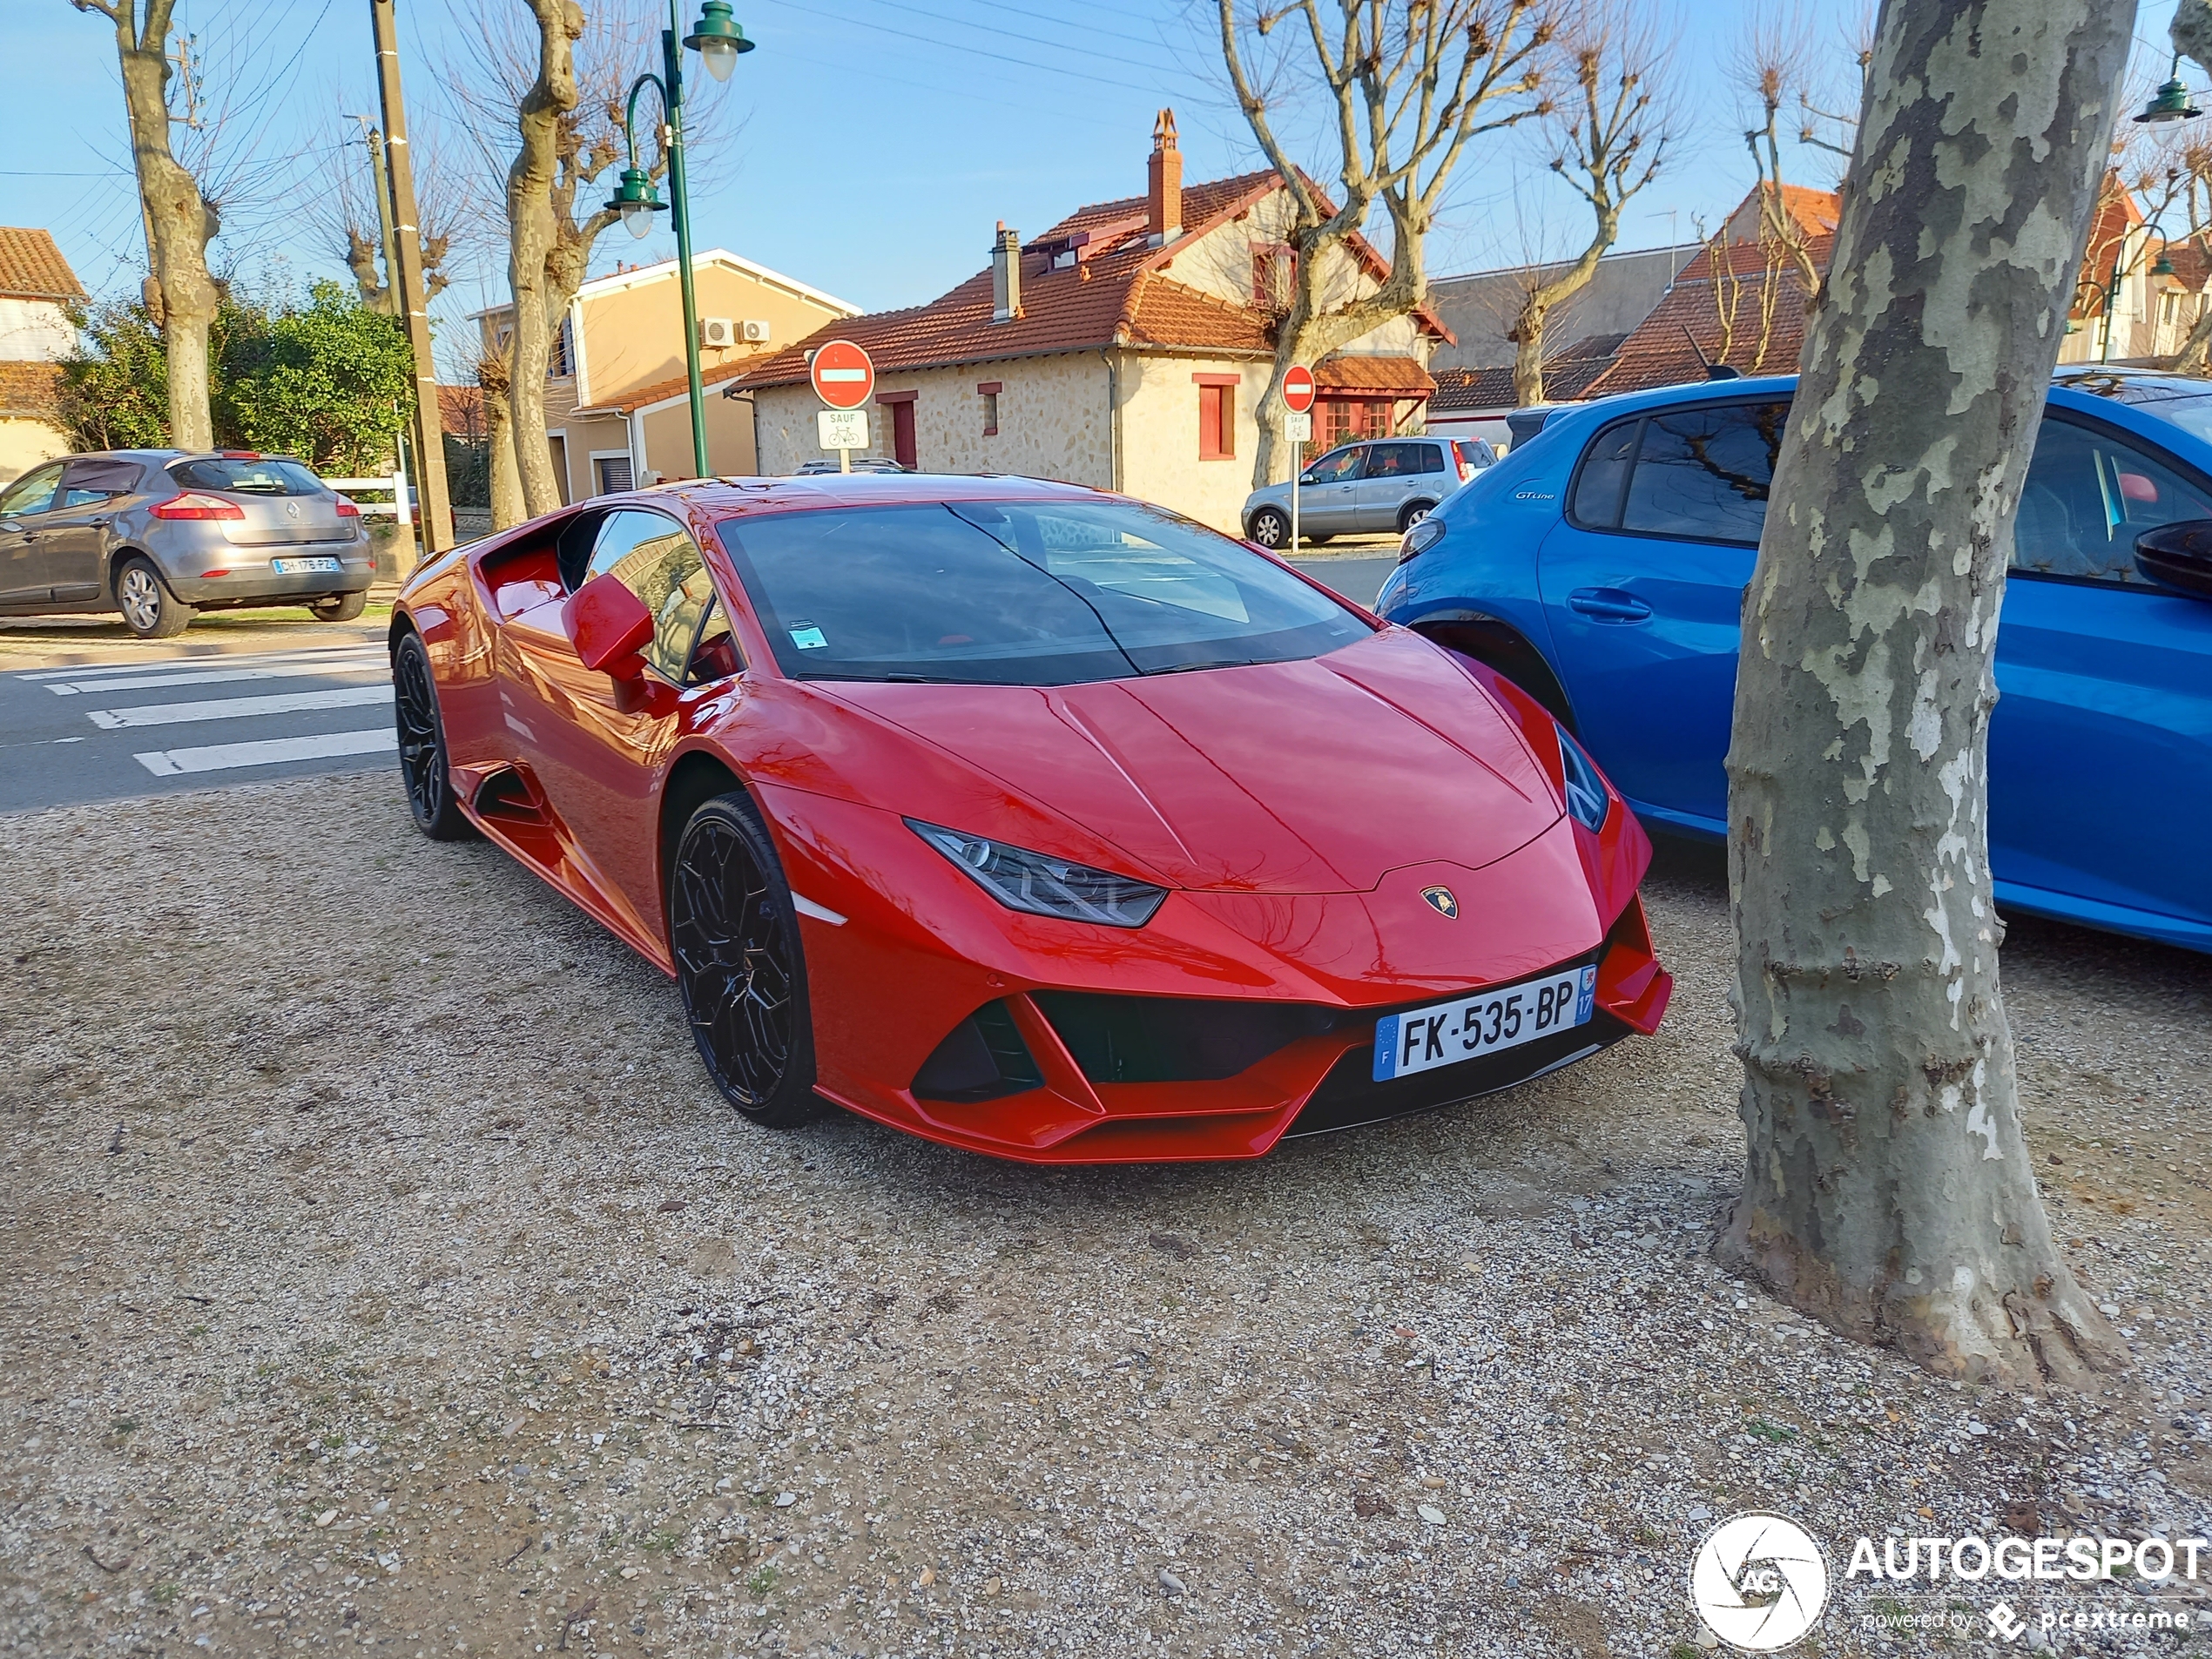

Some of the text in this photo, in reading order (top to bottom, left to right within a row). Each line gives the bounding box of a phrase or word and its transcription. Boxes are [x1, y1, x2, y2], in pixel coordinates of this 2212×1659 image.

[830, 414, 855, 423] SAUF
[1381, 1050, 1390, 1064] F
[1402, 981, 1573, 1067] FK-535-BP
[1578, 994, 1592, 1015] 17
